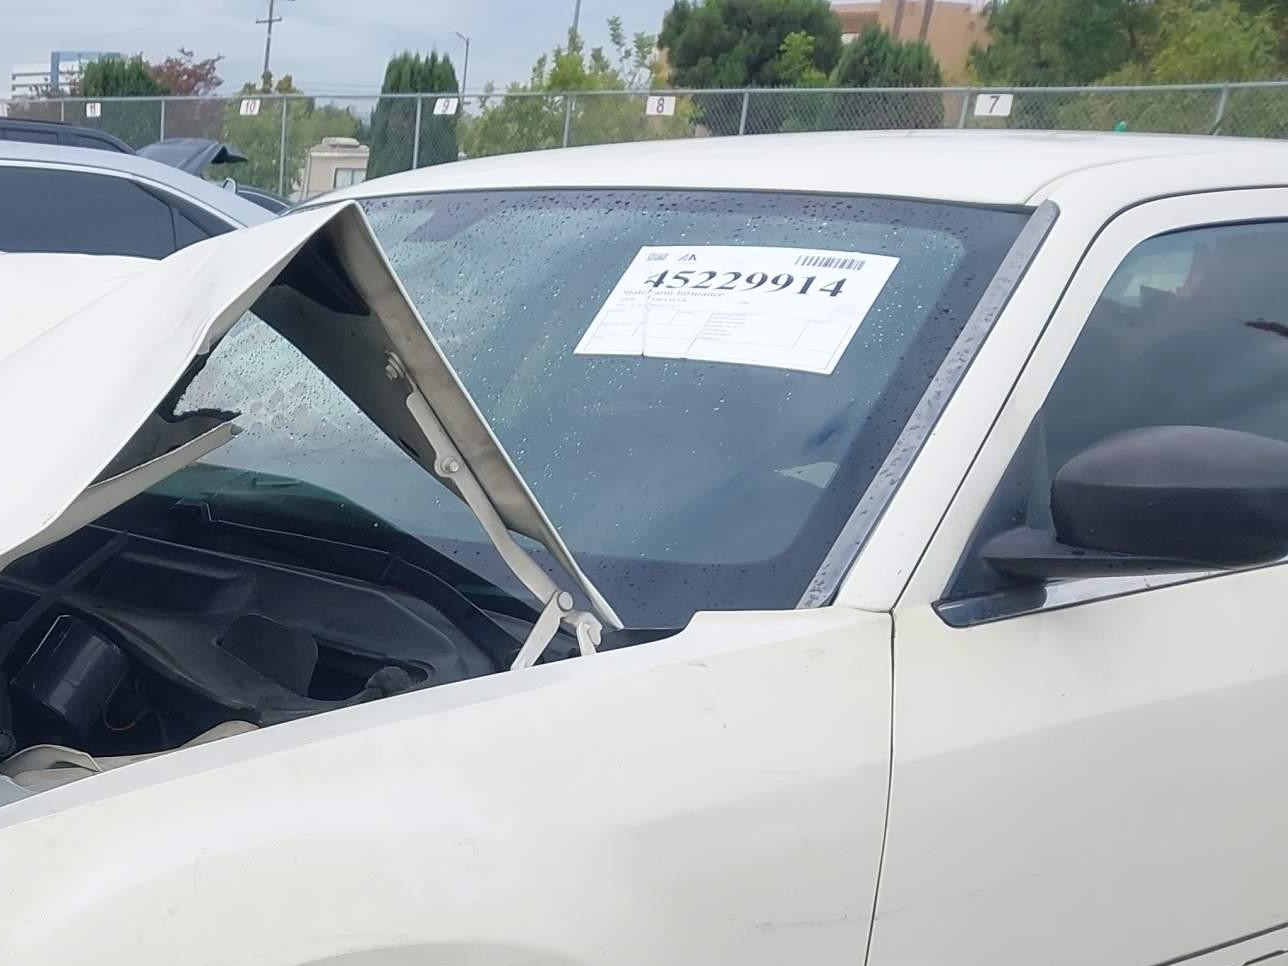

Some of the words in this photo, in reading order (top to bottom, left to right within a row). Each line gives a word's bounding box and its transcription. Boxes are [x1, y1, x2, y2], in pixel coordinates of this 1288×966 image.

[243, 100, 255, 113] 10
[442, 99, 450, 113] 9
[656, 96, 665, 113] 8
[988, 95, 1000, 113] 7
[644, 269, 848, 298] 45229914
